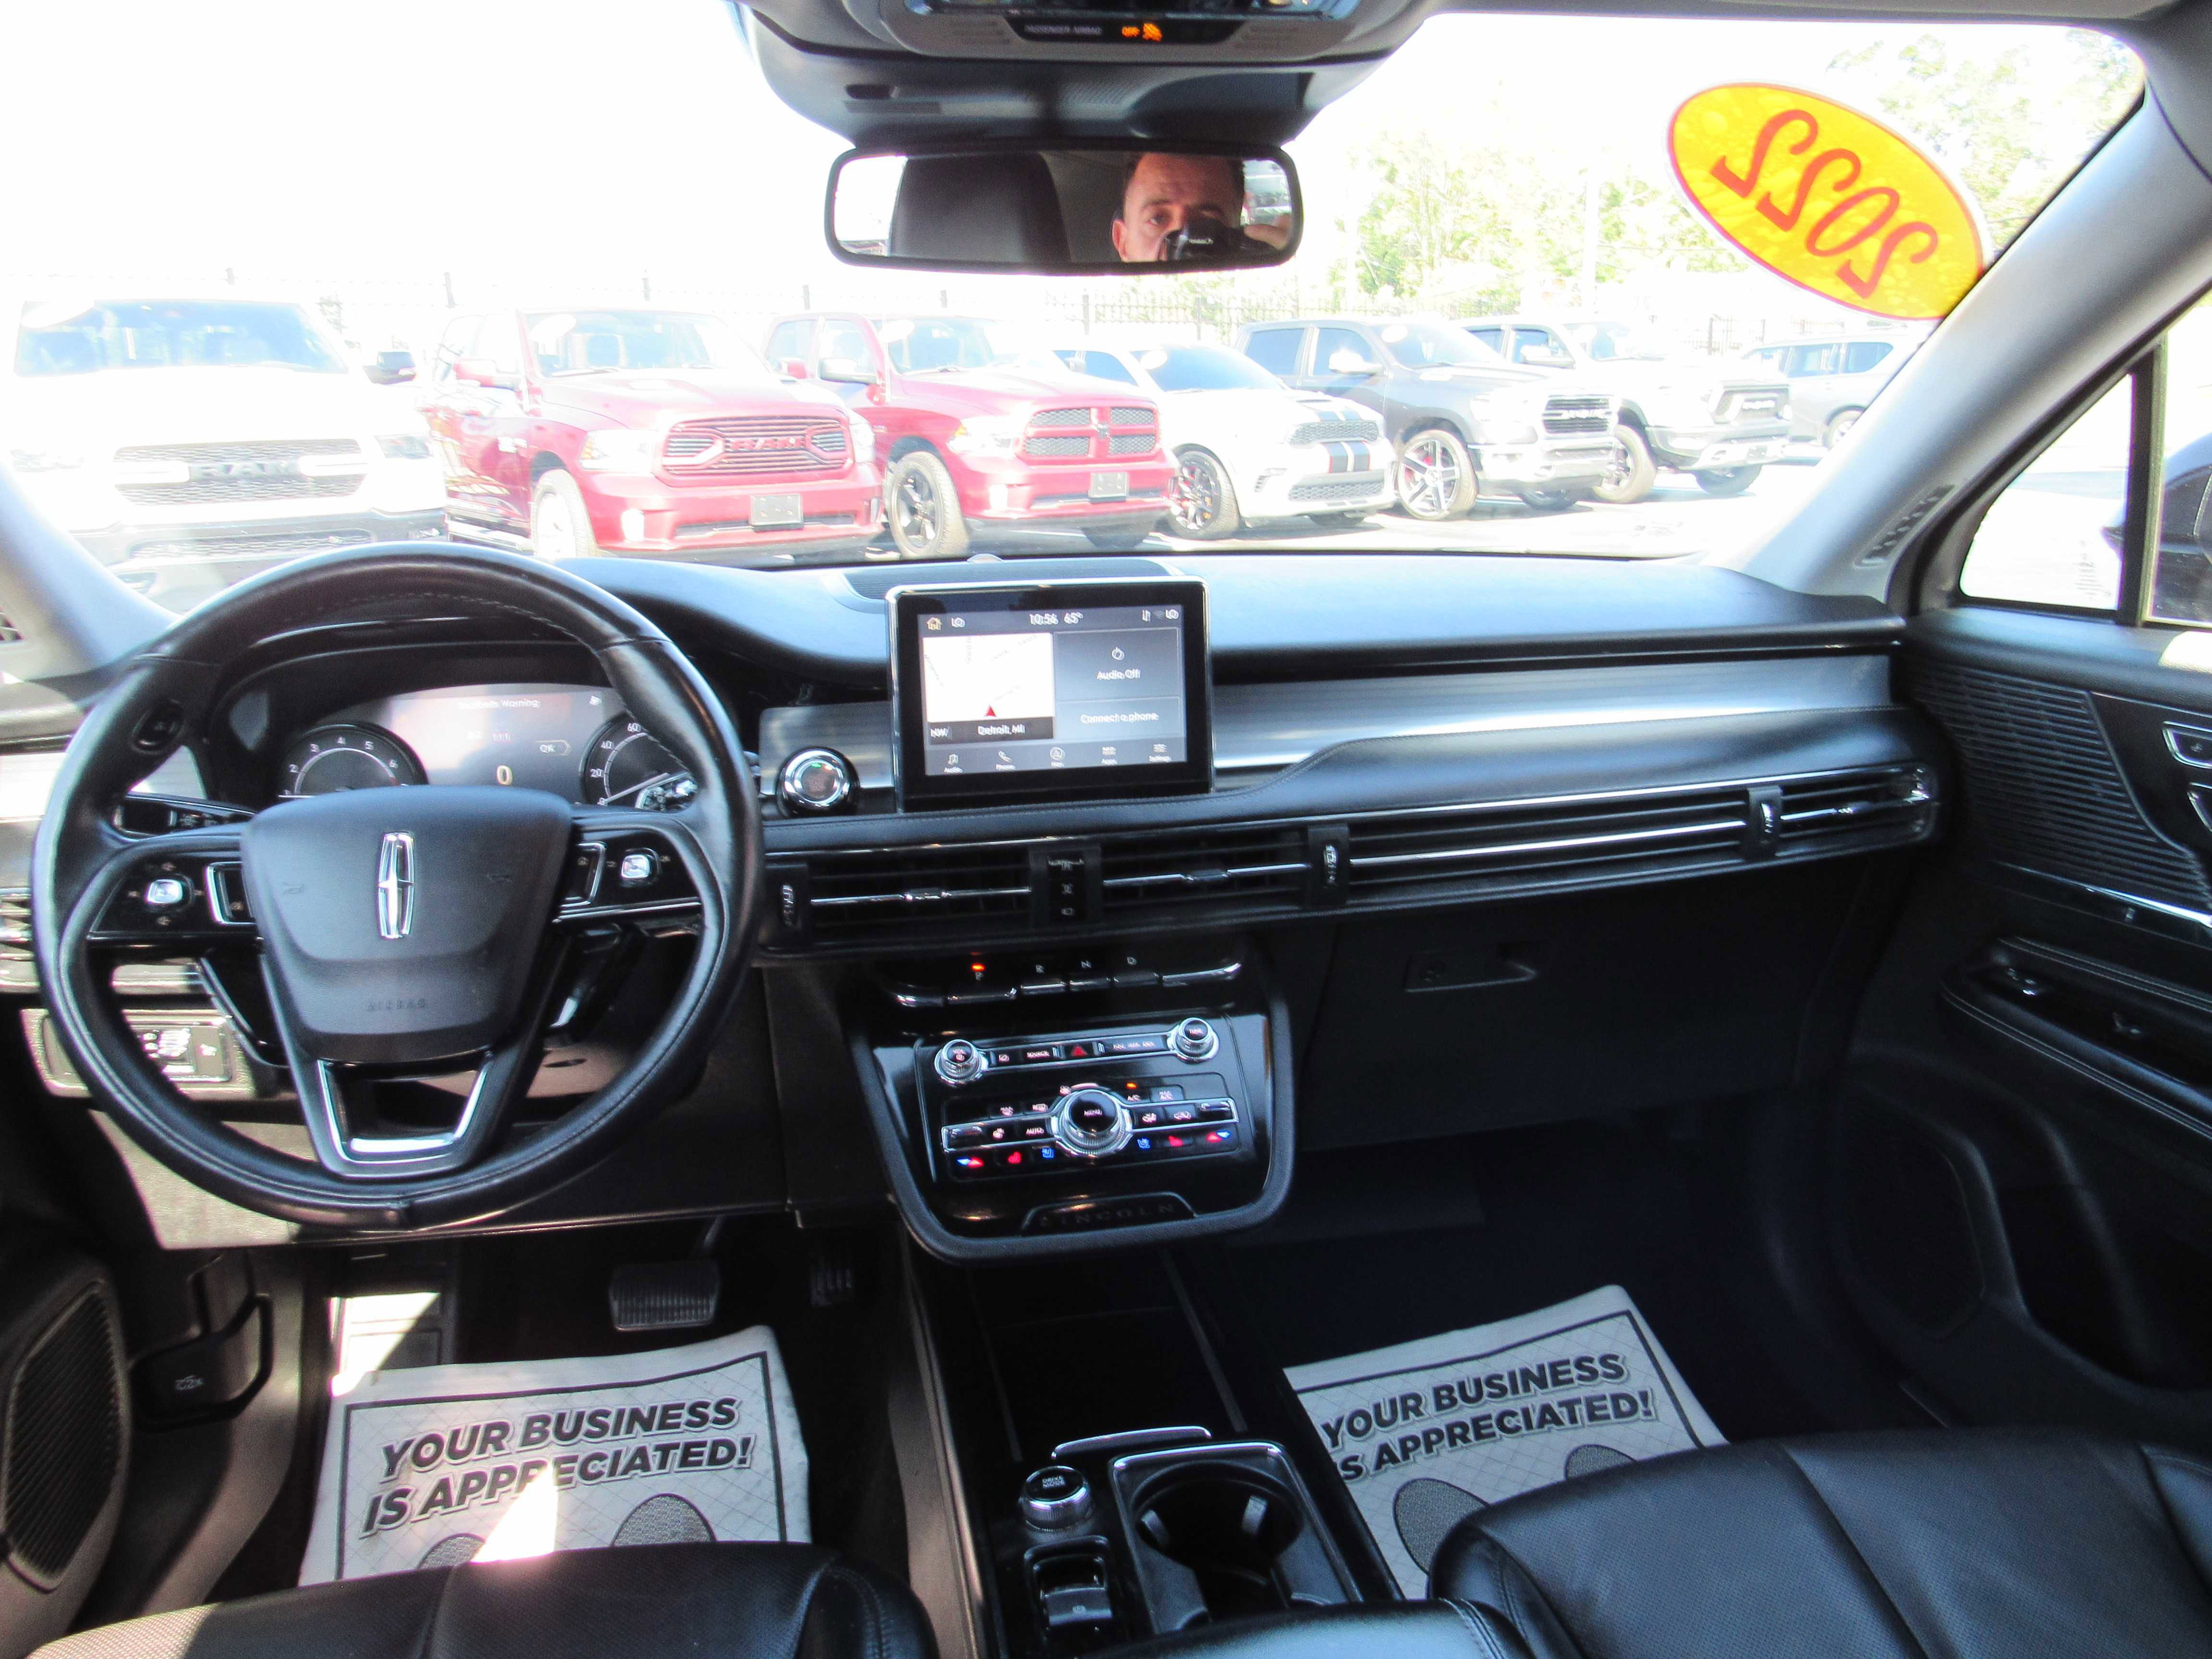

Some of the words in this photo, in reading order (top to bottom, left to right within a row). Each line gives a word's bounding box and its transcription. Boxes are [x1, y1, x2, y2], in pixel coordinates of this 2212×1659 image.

[192, 462, 298, 477] RAM
[1030, 613, 1058, 625] 10:56
[1097, 670, 1125, 680] Audio
[1125, 669, 1141, 679] Off
[1081, 713, 1119, 724] Connect
[1129, 711, 1159, 723] phone
[930, 728, 949, 738] NW
[365, 741, 374, 750] 5
[289, 764, 299, 773] 2
[590, 769, 604, 778] 20
[496, 765, 514, 786] 0
[1081, 961, 1092, 969] N
[1127, 957, 1137, 965] D
[1036, 964, 1045, 974] R
[1083, 1109, 1103, 1118] MENU
[1322, 1392, 1424, 1448] YOUR
[1433, 1353, 1626, 1413] BUSINESS
[382, 1420, 511, 1478] YOUR
[522, 1397, 739, 1447] BUSINESS
[1334, 1455, 1366, 1481] S
[1375, 1389, 1654, 1471] APPRECIATED!
[362, 1486, 413, 1535] IS
